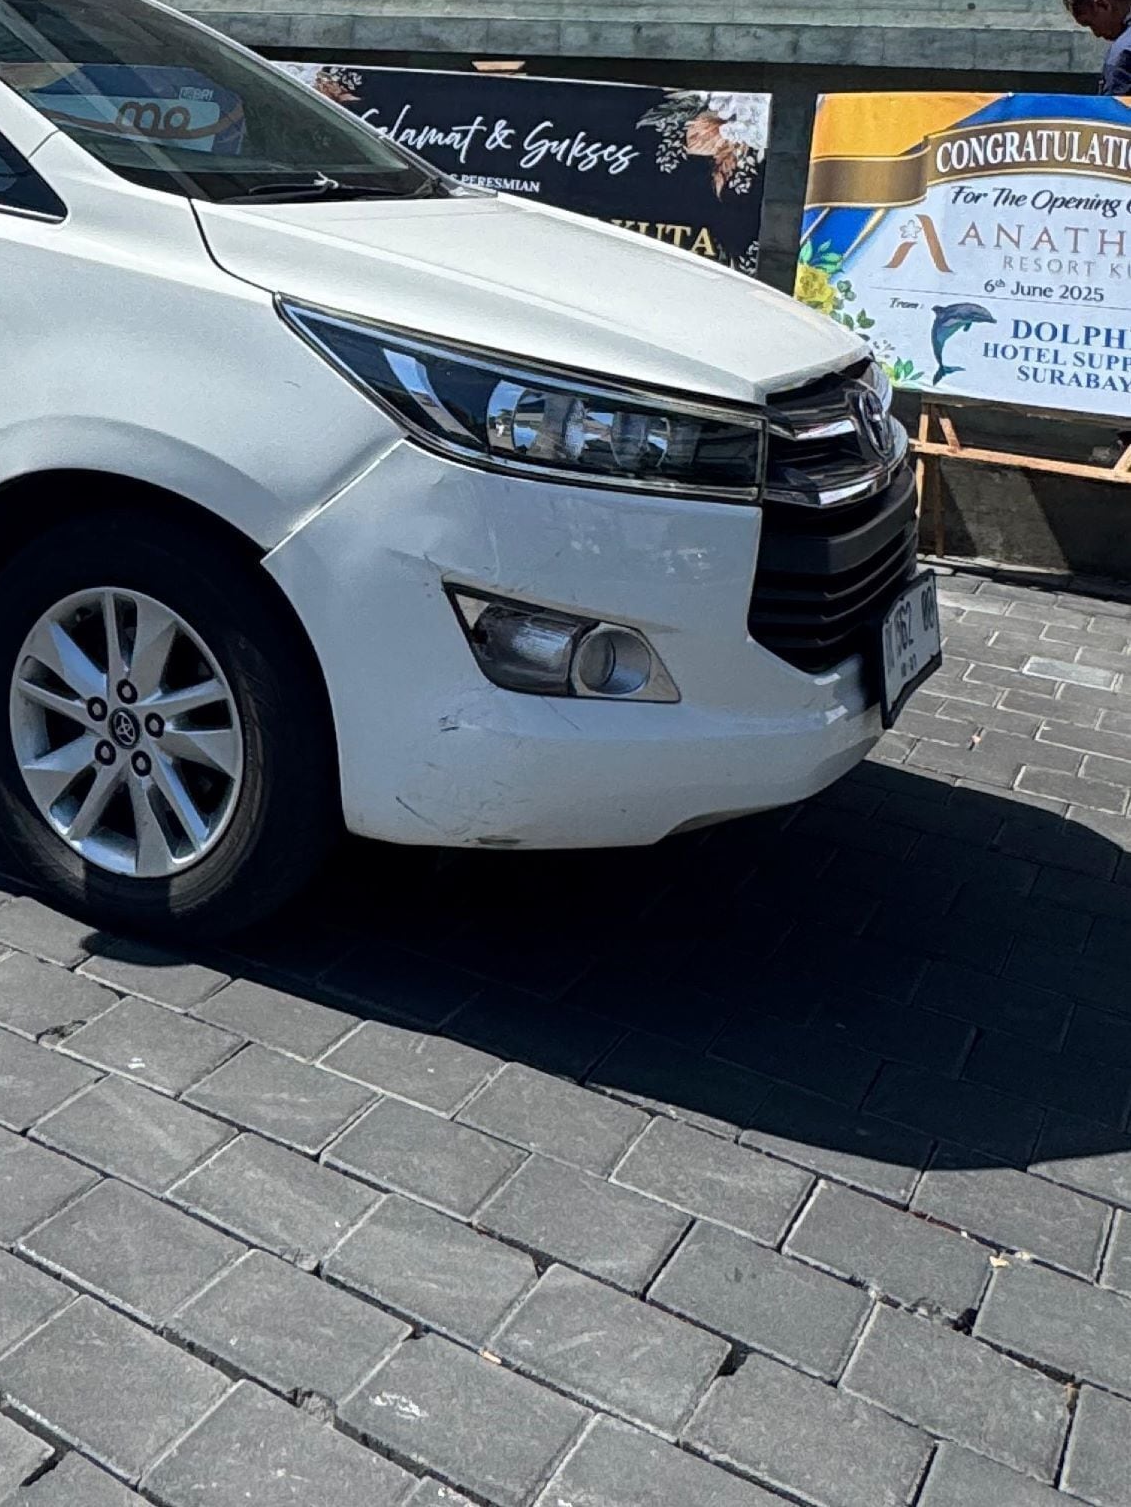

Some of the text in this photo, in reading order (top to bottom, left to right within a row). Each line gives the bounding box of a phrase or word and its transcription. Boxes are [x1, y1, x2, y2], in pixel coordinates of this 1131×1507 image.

[485, 119, 516, 150] &
[520, 120, 641, 175] Sukses
[936, 129, 1131, 173] CONGRATULATI
[461, 174, 541, 193] PERESMIAN
[951, 185, 988, 205] For
[992, 187, 1027, 207] The
[1030, 189, 1122, 218] Opening
[957, 220, 1127, 257] ANATH
[1002, 255, 1096, 278] RESORT
[1010, 281, 1054, 299] June
[1059, 284, 1105, 303] 2025
[1011, 318, 1131, 351] DOLPH
[982, 342, 1067, 367] HOTEL
